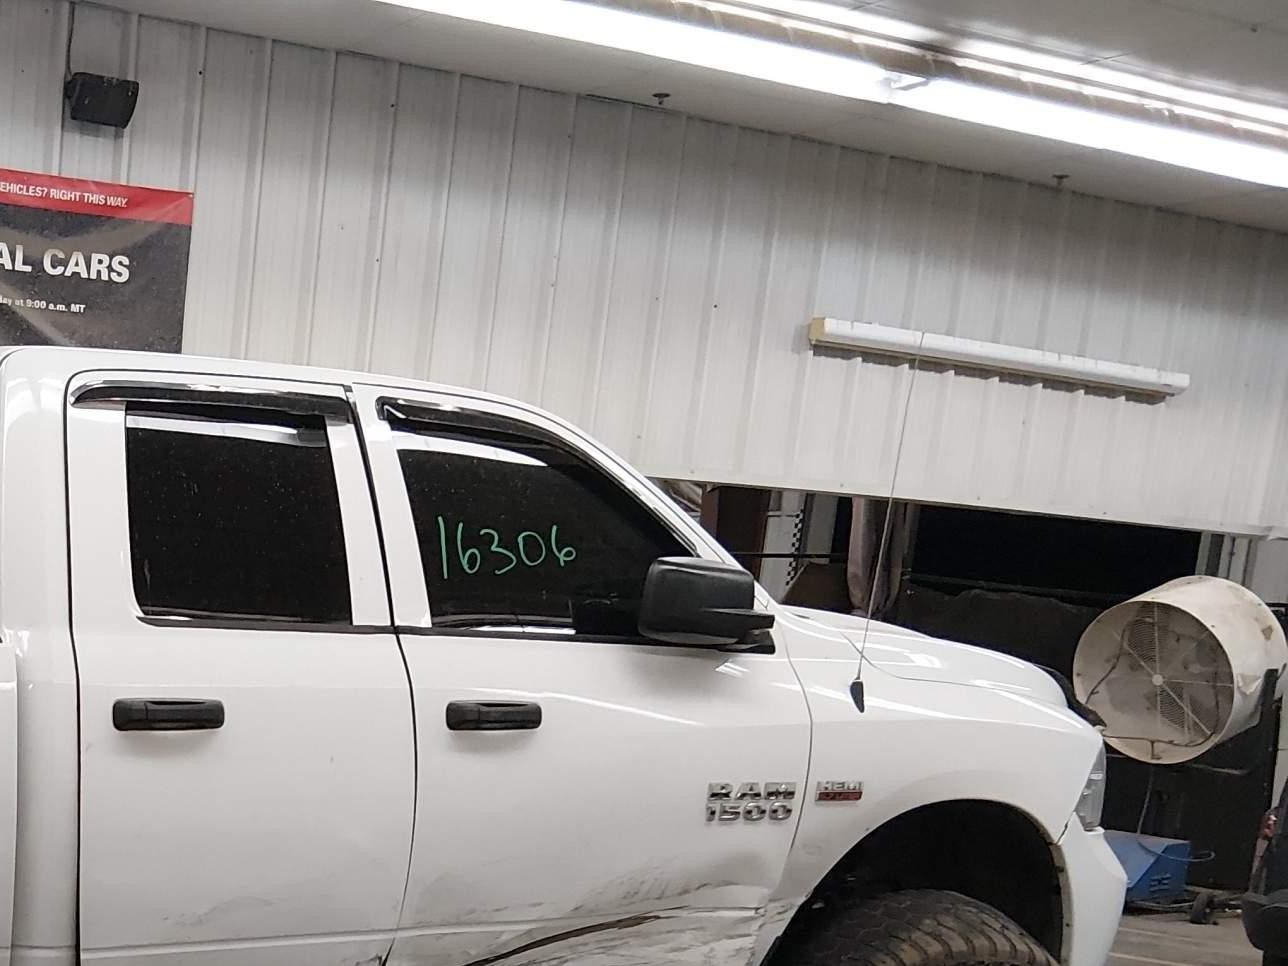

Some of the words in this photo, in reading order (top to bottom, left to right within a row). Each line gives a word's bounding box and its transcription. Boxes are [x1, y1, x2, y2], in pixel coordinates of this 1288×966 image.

[49, 188, 82, 202] RIGHT
[83, 192, 106, 205] THIS
[43, 248, 130, 284] CARS
[14, 297, 25, 306] at
[25, 299, 47, 309] 9:00
[48, 303, 68, 312] a.m.
[70, 303, 86, 313] MT
[437, 515, 577, 579] 16306
[708, 782, 797, 800] RAM
[705, 801, 793, 822] 1500
